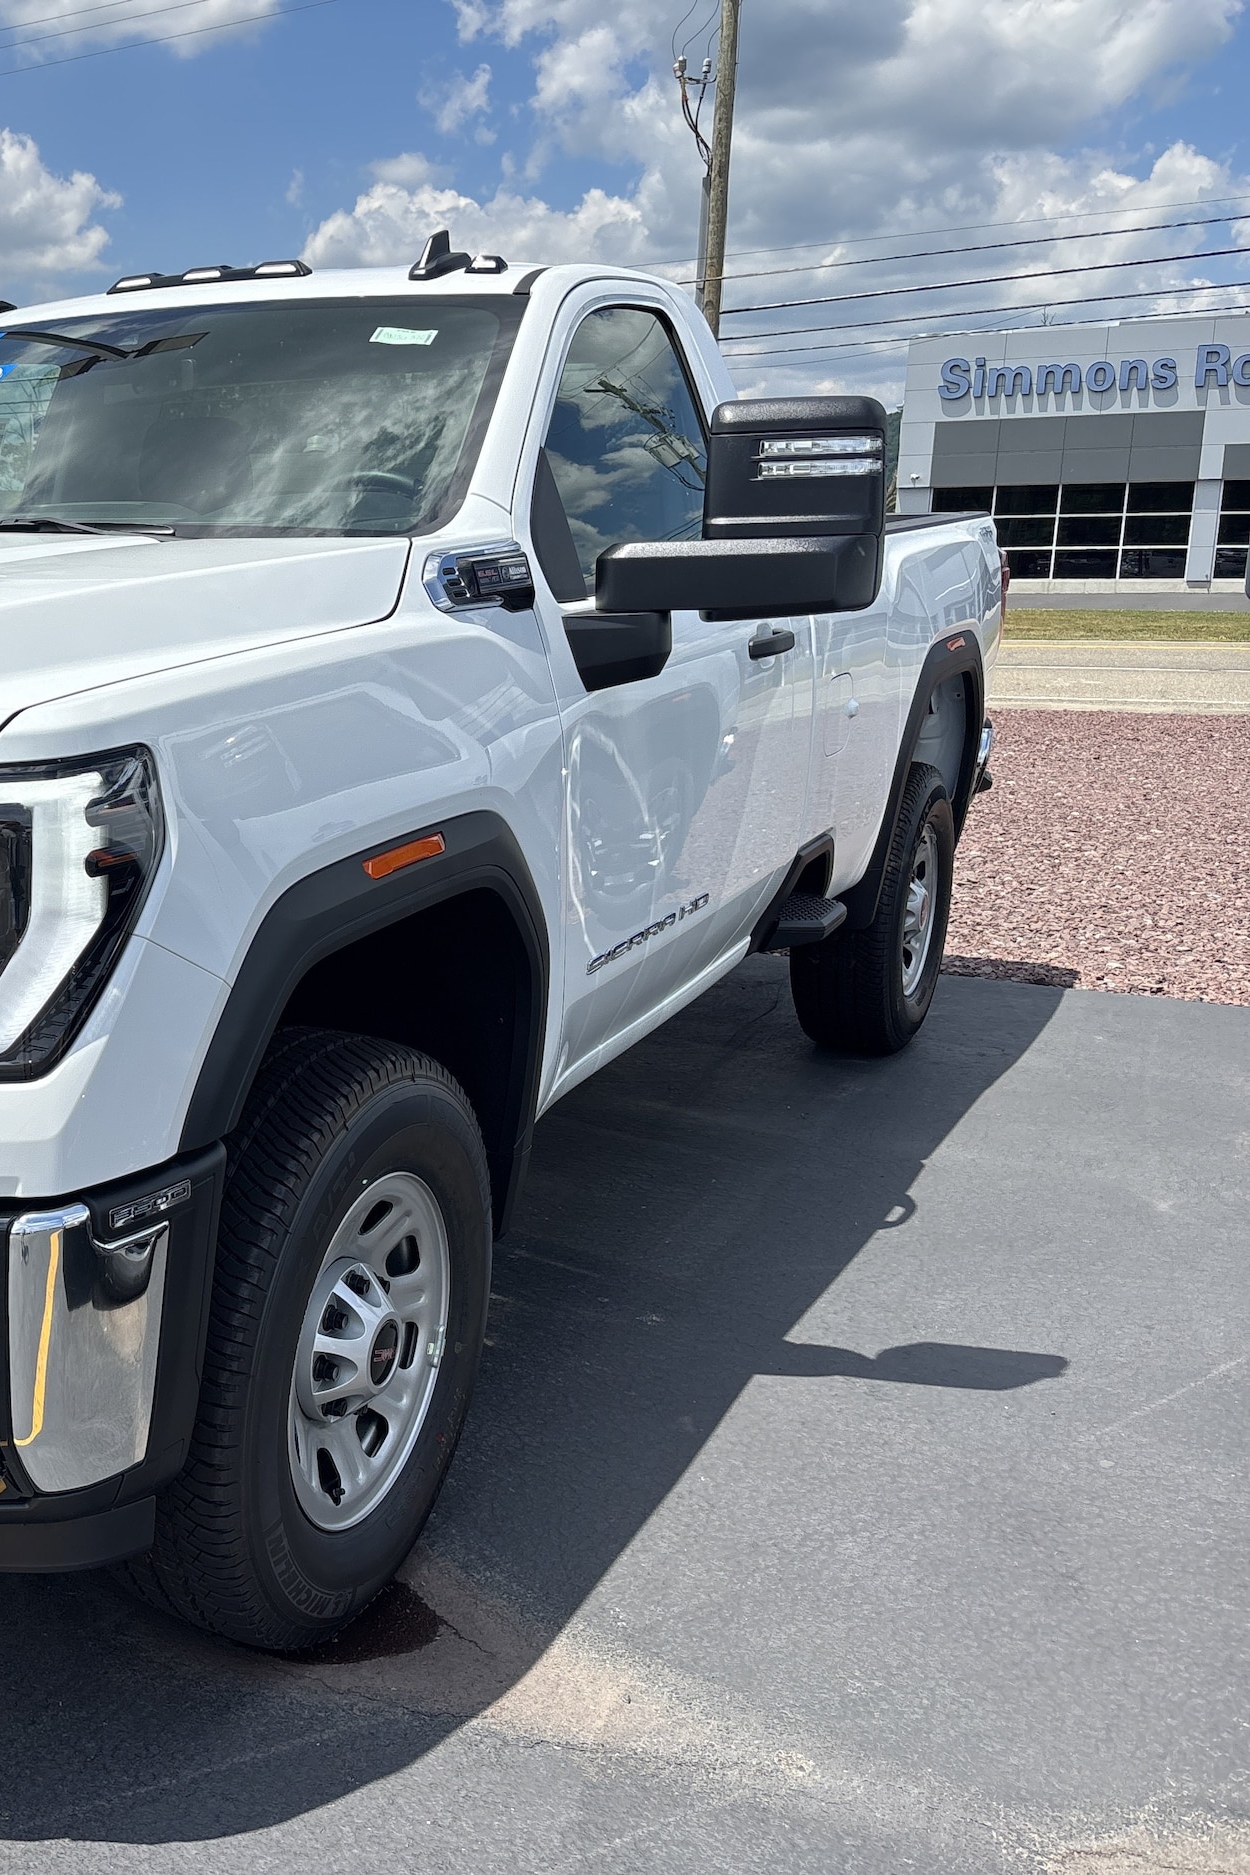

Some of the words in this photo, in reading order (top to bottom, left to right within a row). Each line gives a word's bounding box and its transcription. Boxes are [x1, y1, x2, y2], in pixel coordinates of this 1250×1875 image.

[937, 356, 1178, 400] Simmons
[586, 912, 676, 975] SIERRA
[678, 893, 709, 921] HD
[266, 1533, 332, 1617] MICHELIN
